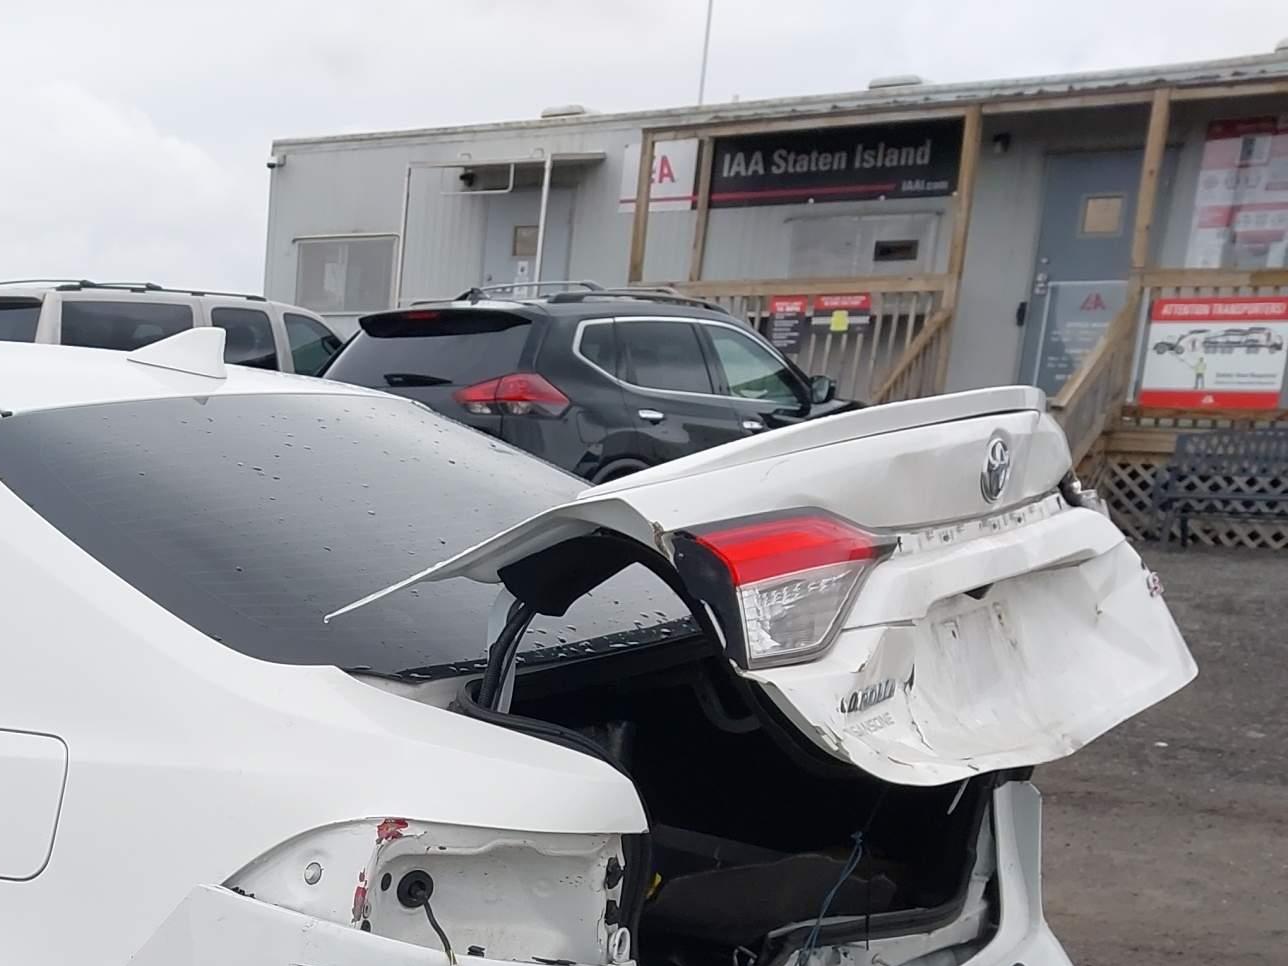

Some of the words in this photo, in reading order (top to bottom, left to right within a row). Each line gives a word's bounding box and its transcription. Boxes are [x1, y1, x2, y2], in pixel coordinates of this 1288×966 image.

[722, 152, 764, 177] IAA
[771, 147, 848, 175] Staten
[854, 139, 932, 169] Island
